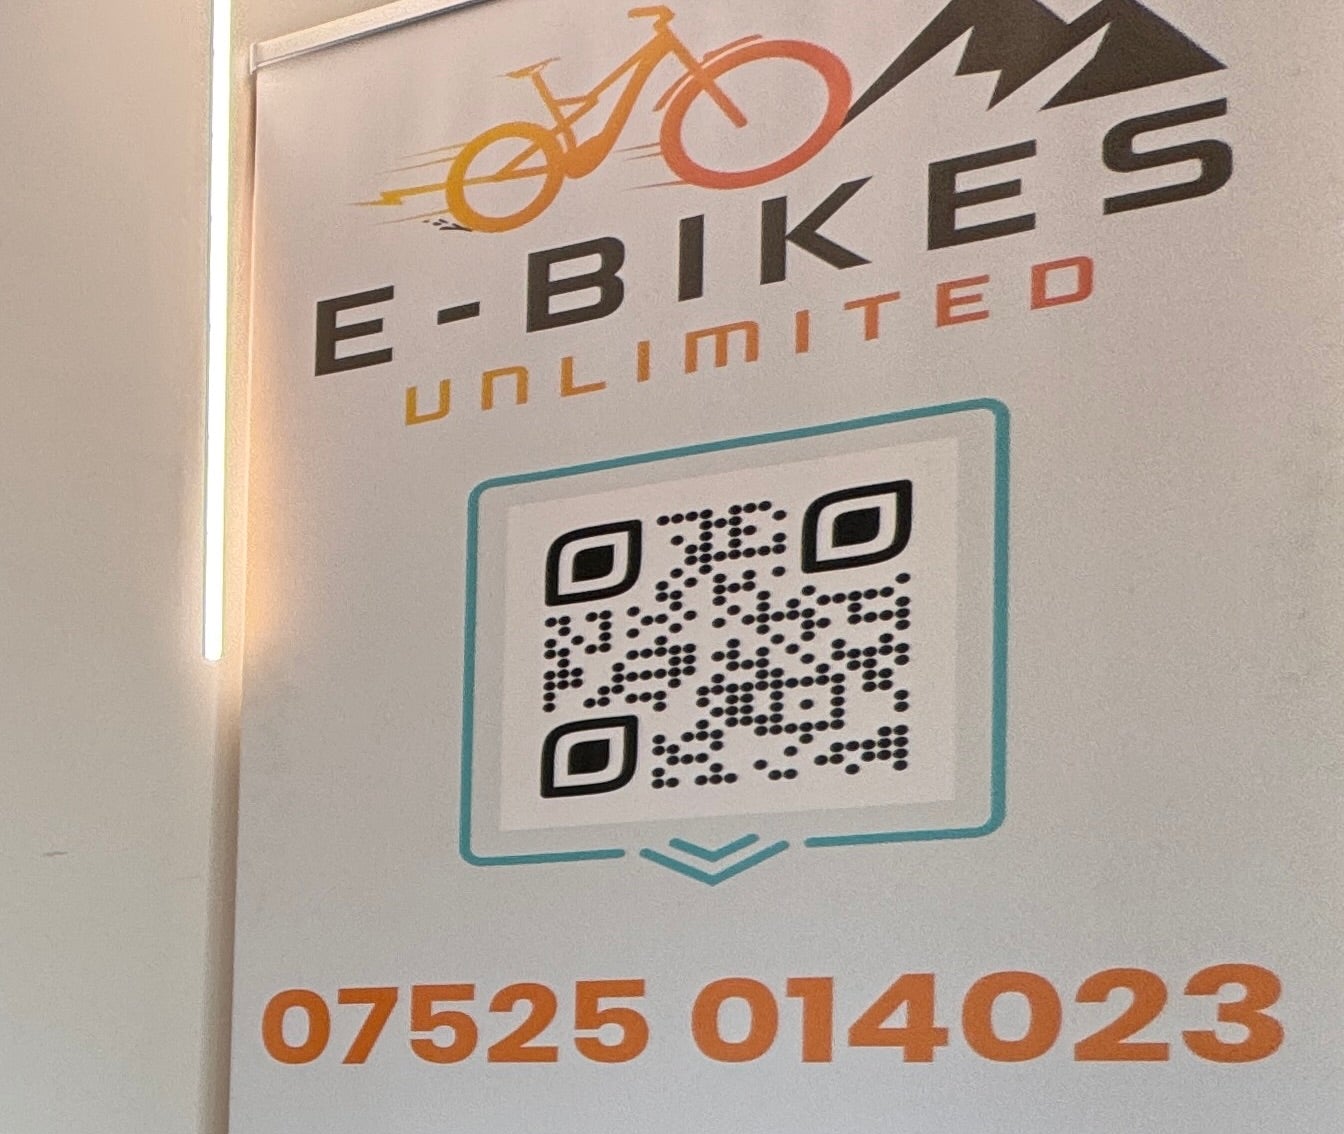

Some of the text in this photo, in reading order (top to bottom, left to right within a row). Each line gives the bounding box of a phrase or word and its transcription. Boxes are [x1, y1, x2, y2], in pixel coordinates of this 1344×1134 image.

[314, 97, 1234, 377] E-BIKES
[404, 256, 1095, 426] UNLIMITED
[261, 963, 1285, 1064] 07525 014023
